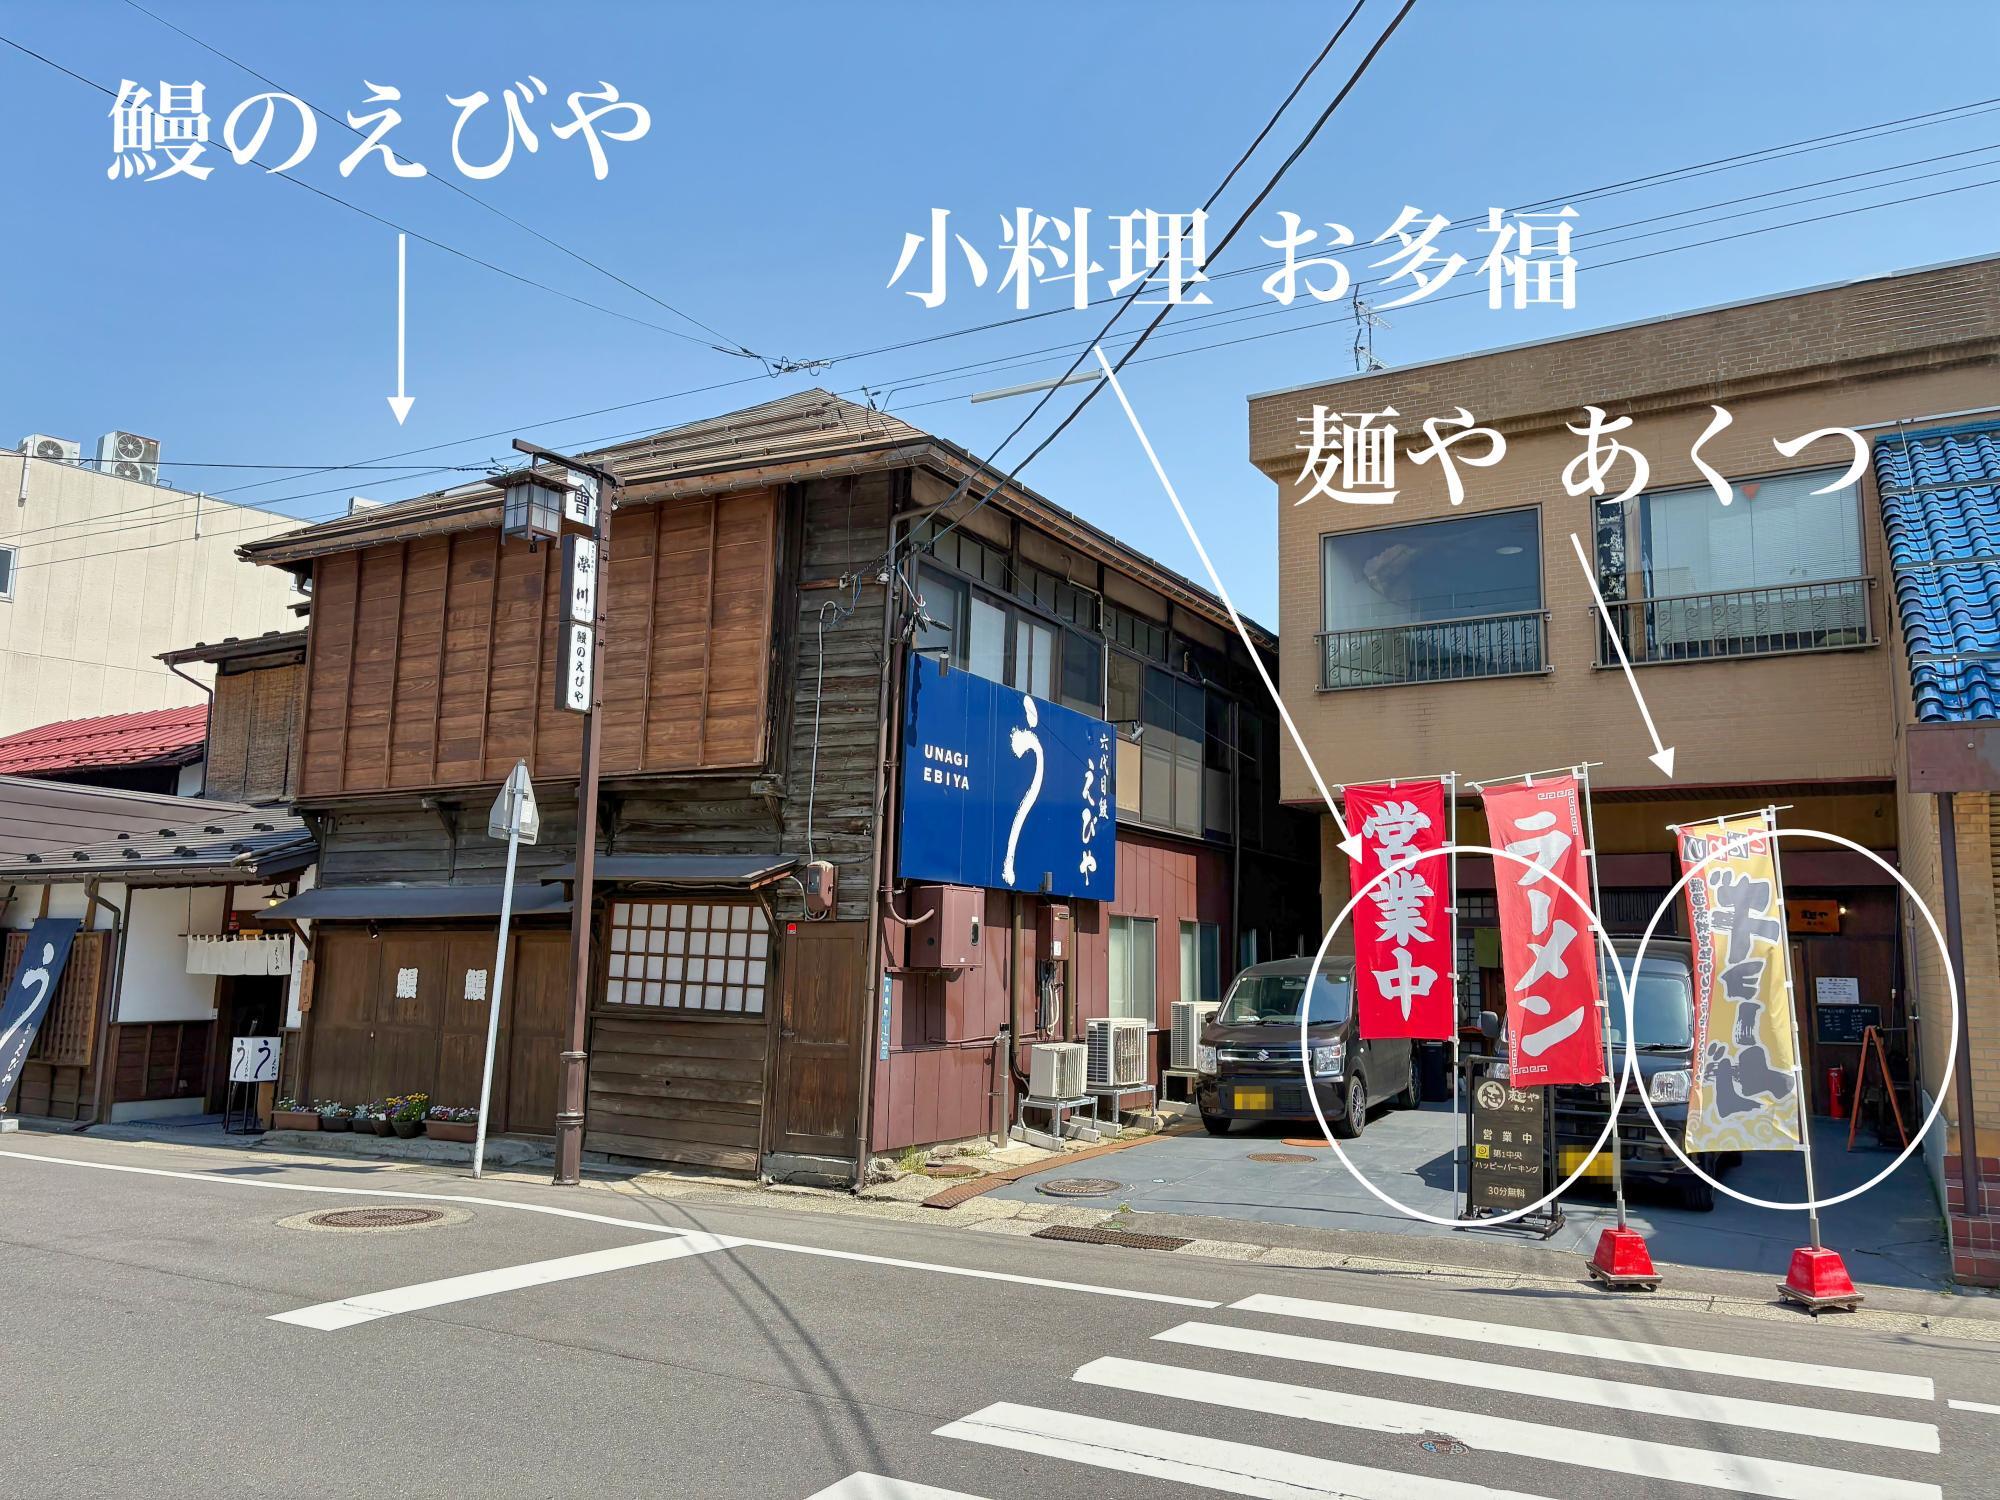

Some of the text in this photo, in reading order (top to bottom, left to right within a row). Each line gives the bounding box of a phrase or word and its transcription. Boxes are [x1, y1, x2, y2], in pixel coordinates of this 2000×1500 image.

[573, 629, 587, 704] 鰻のえびや
[924, 744, 969, 767] UNAGI
[923, 767, 970, 791] EBIYA
[1079, 758, 1097, 886] えびや
[1361, 800, 1438, 1021] 営業中
[1504, 810, 1585, 1057] ラーメン
[1507, 1087, 1540, 1104] 麺や
[1513, 1104, 1533, 1113] あくつ
[1483, 1128, 1533, 1145] 営業中
[1493, 1149, 1523, 1160] 第1中央
[1475, 1161, 1539, 1174] ハッピーパーキング
[1488, 1186, 1526, 1198] 30分無料
